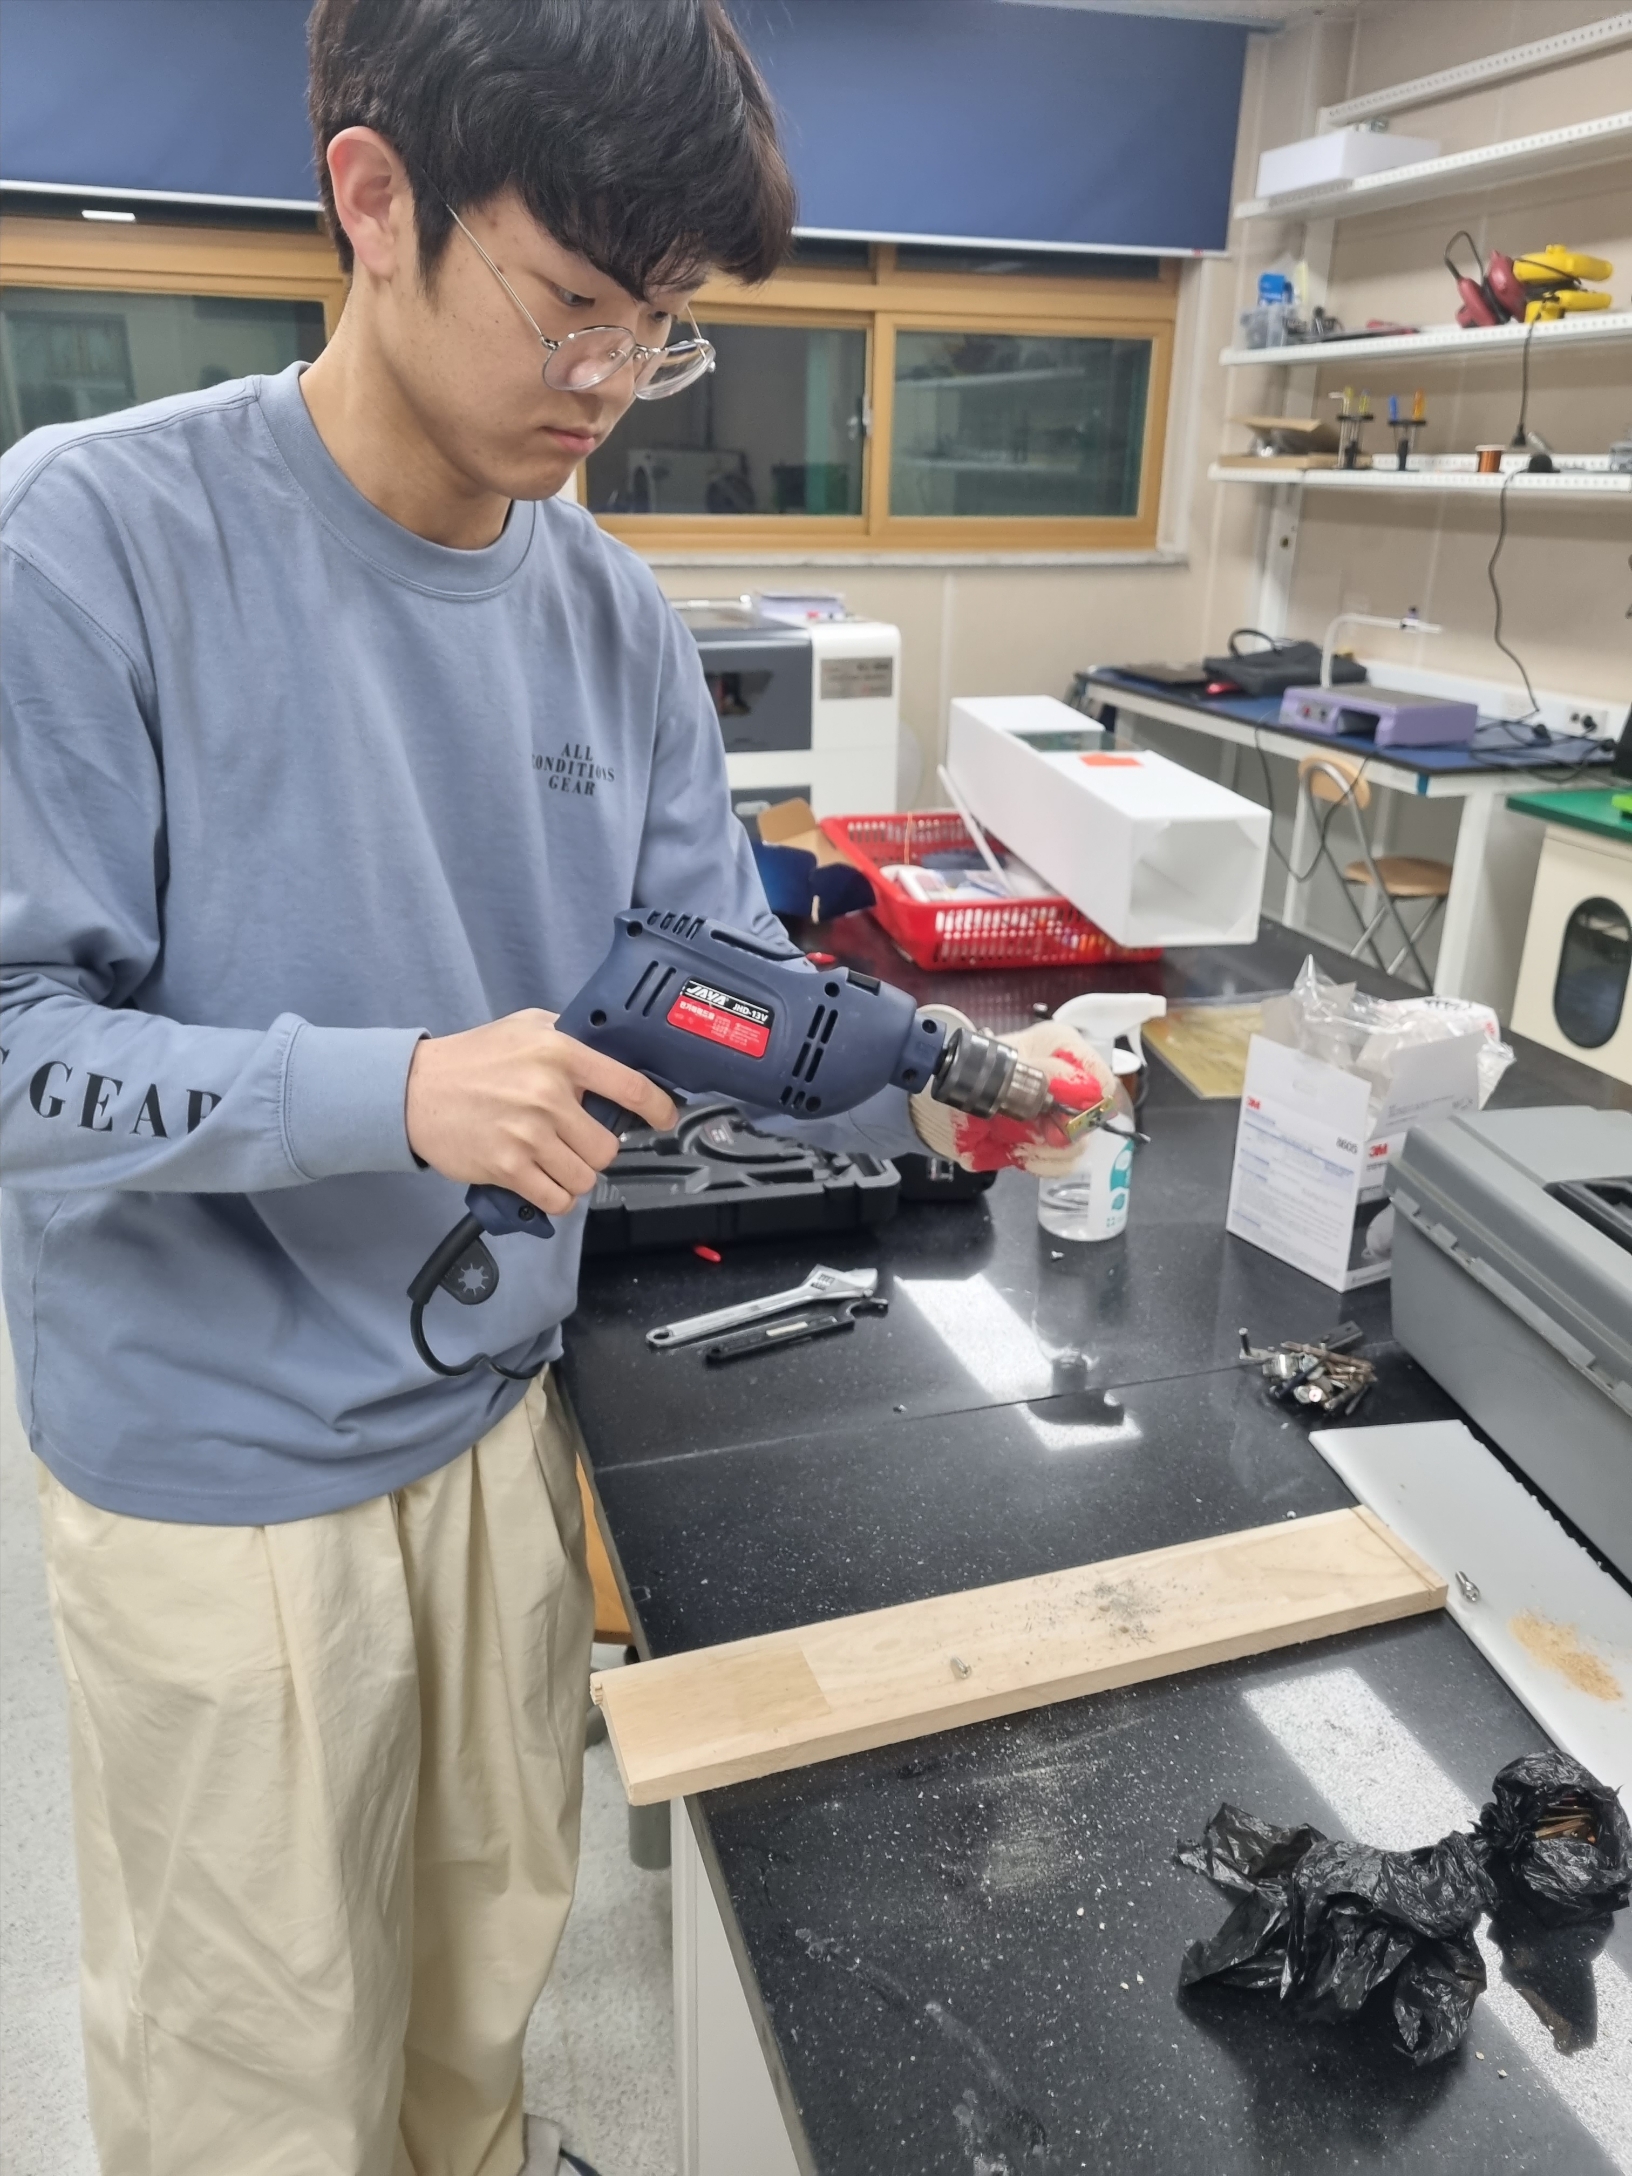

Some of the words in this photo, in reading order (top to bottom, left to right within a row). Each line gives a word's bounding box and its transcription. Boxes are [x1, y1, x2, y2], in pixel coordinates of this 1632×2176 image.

[561, 742, 593, 761] ALL
[548, 774, 596, 796] GEAR
[686, 985, 727, 1006] JAVA
[1369, 1143, 1388, 1158] 3M
